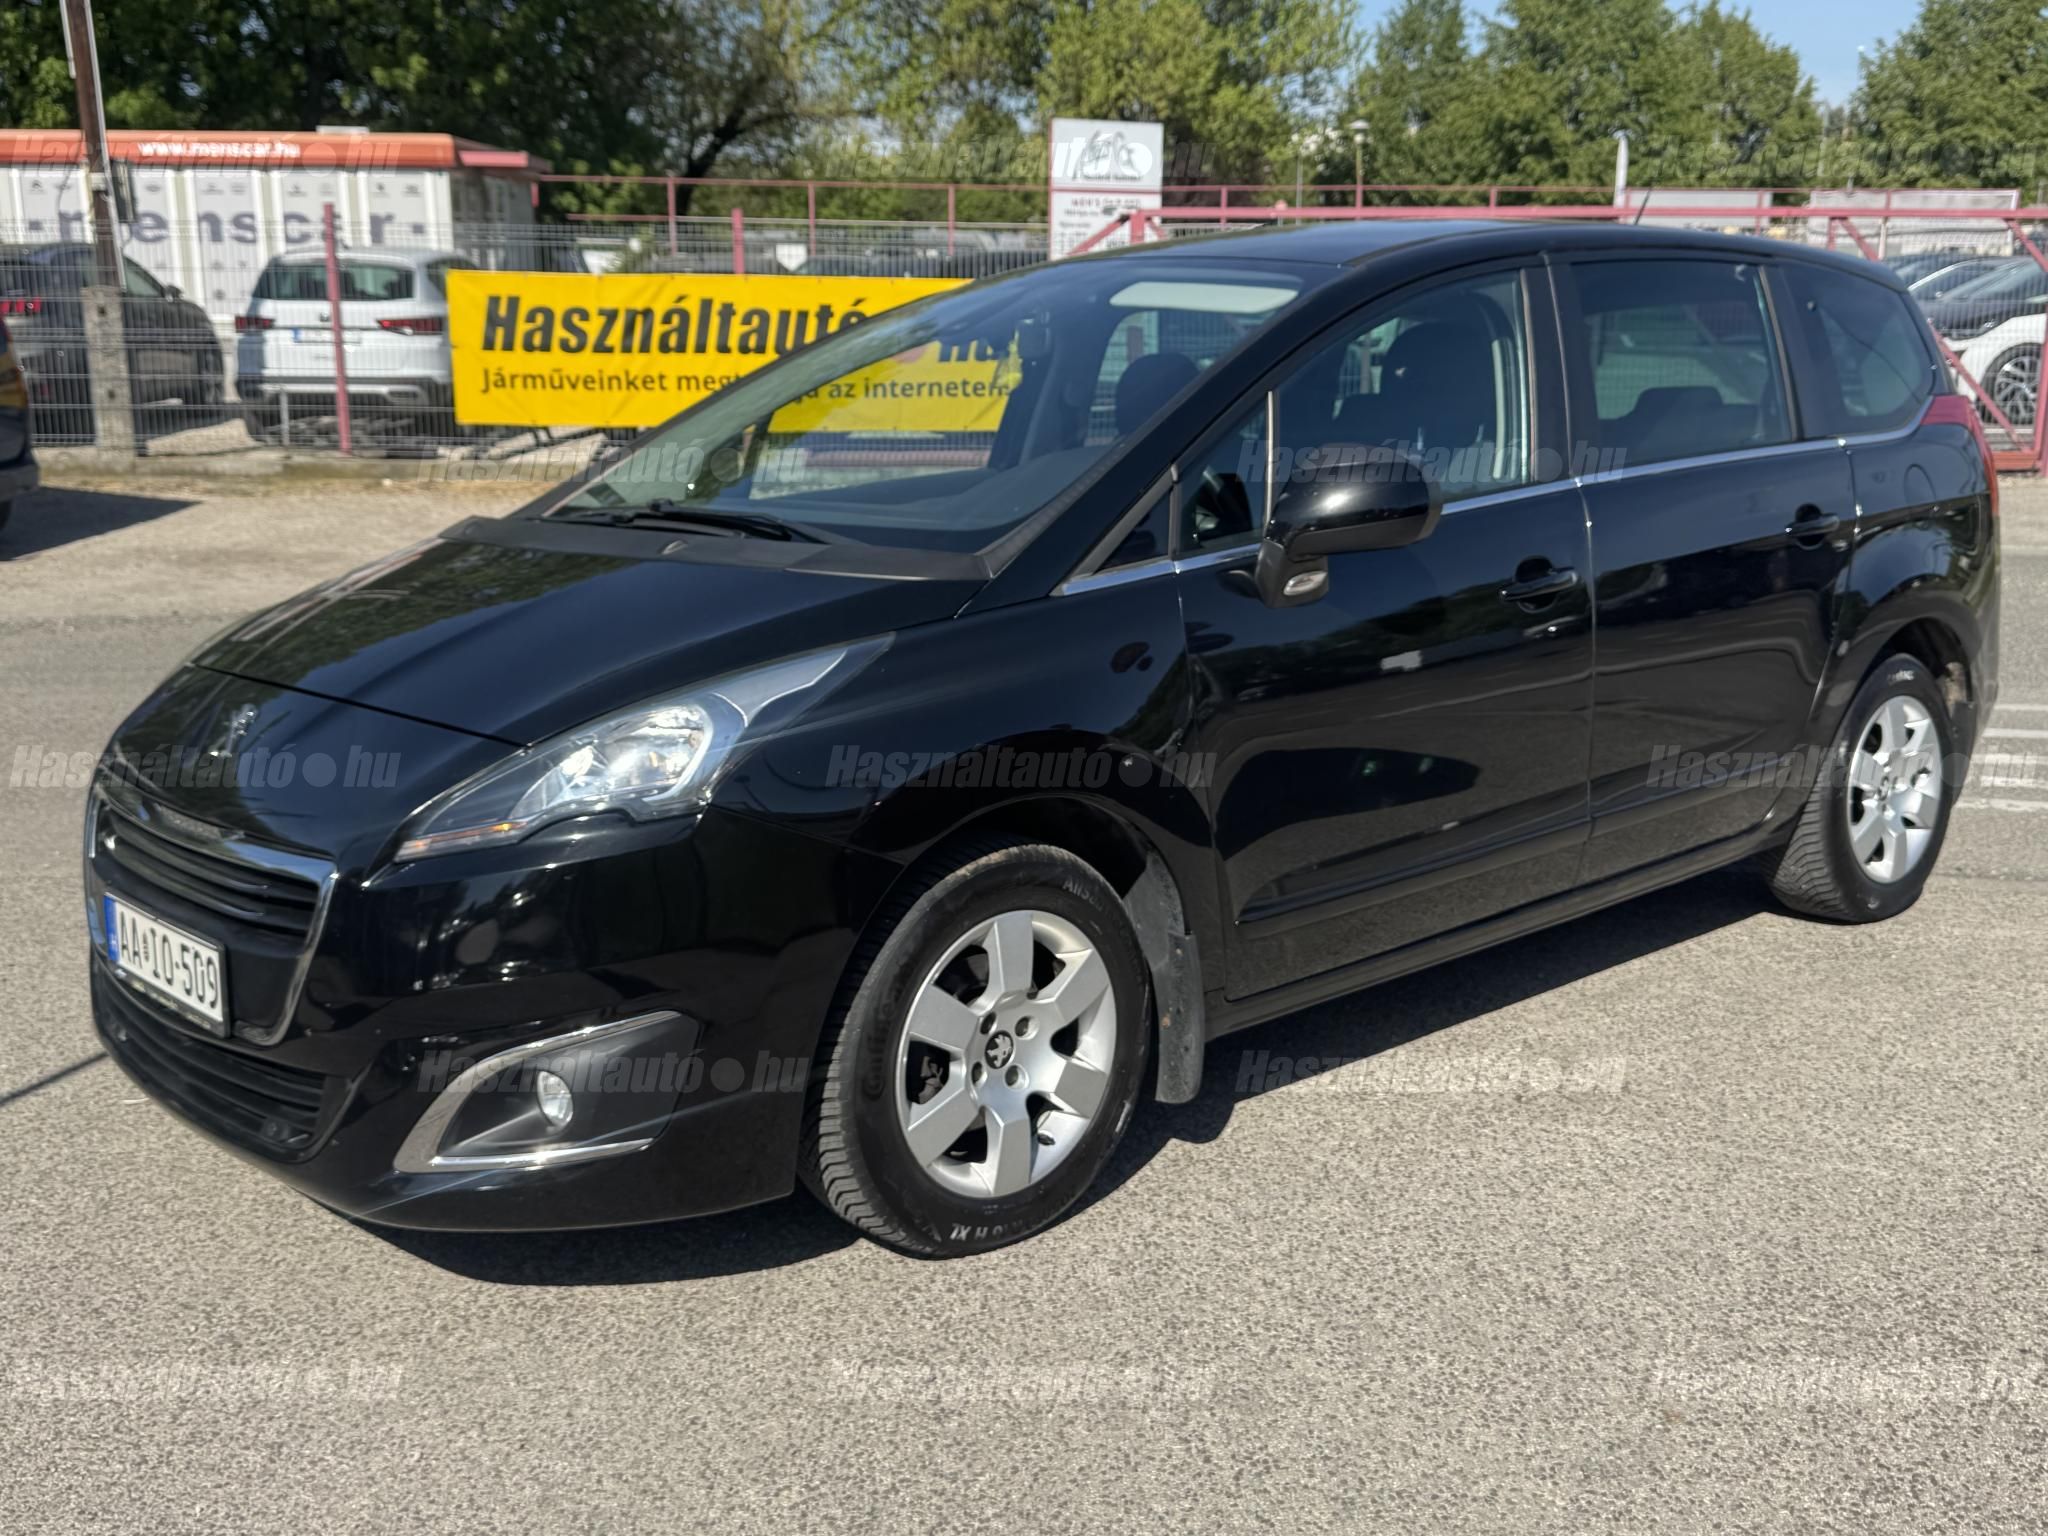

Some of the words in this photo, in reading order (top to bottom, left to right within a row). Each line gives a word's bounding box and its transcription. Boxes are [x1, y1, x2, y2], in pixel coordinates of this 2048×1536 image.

[137, 139, 300, 158] www.menscar.hu
[482, 366, 668, 393] Járműveinket
[829, 383, 857, 398] az
